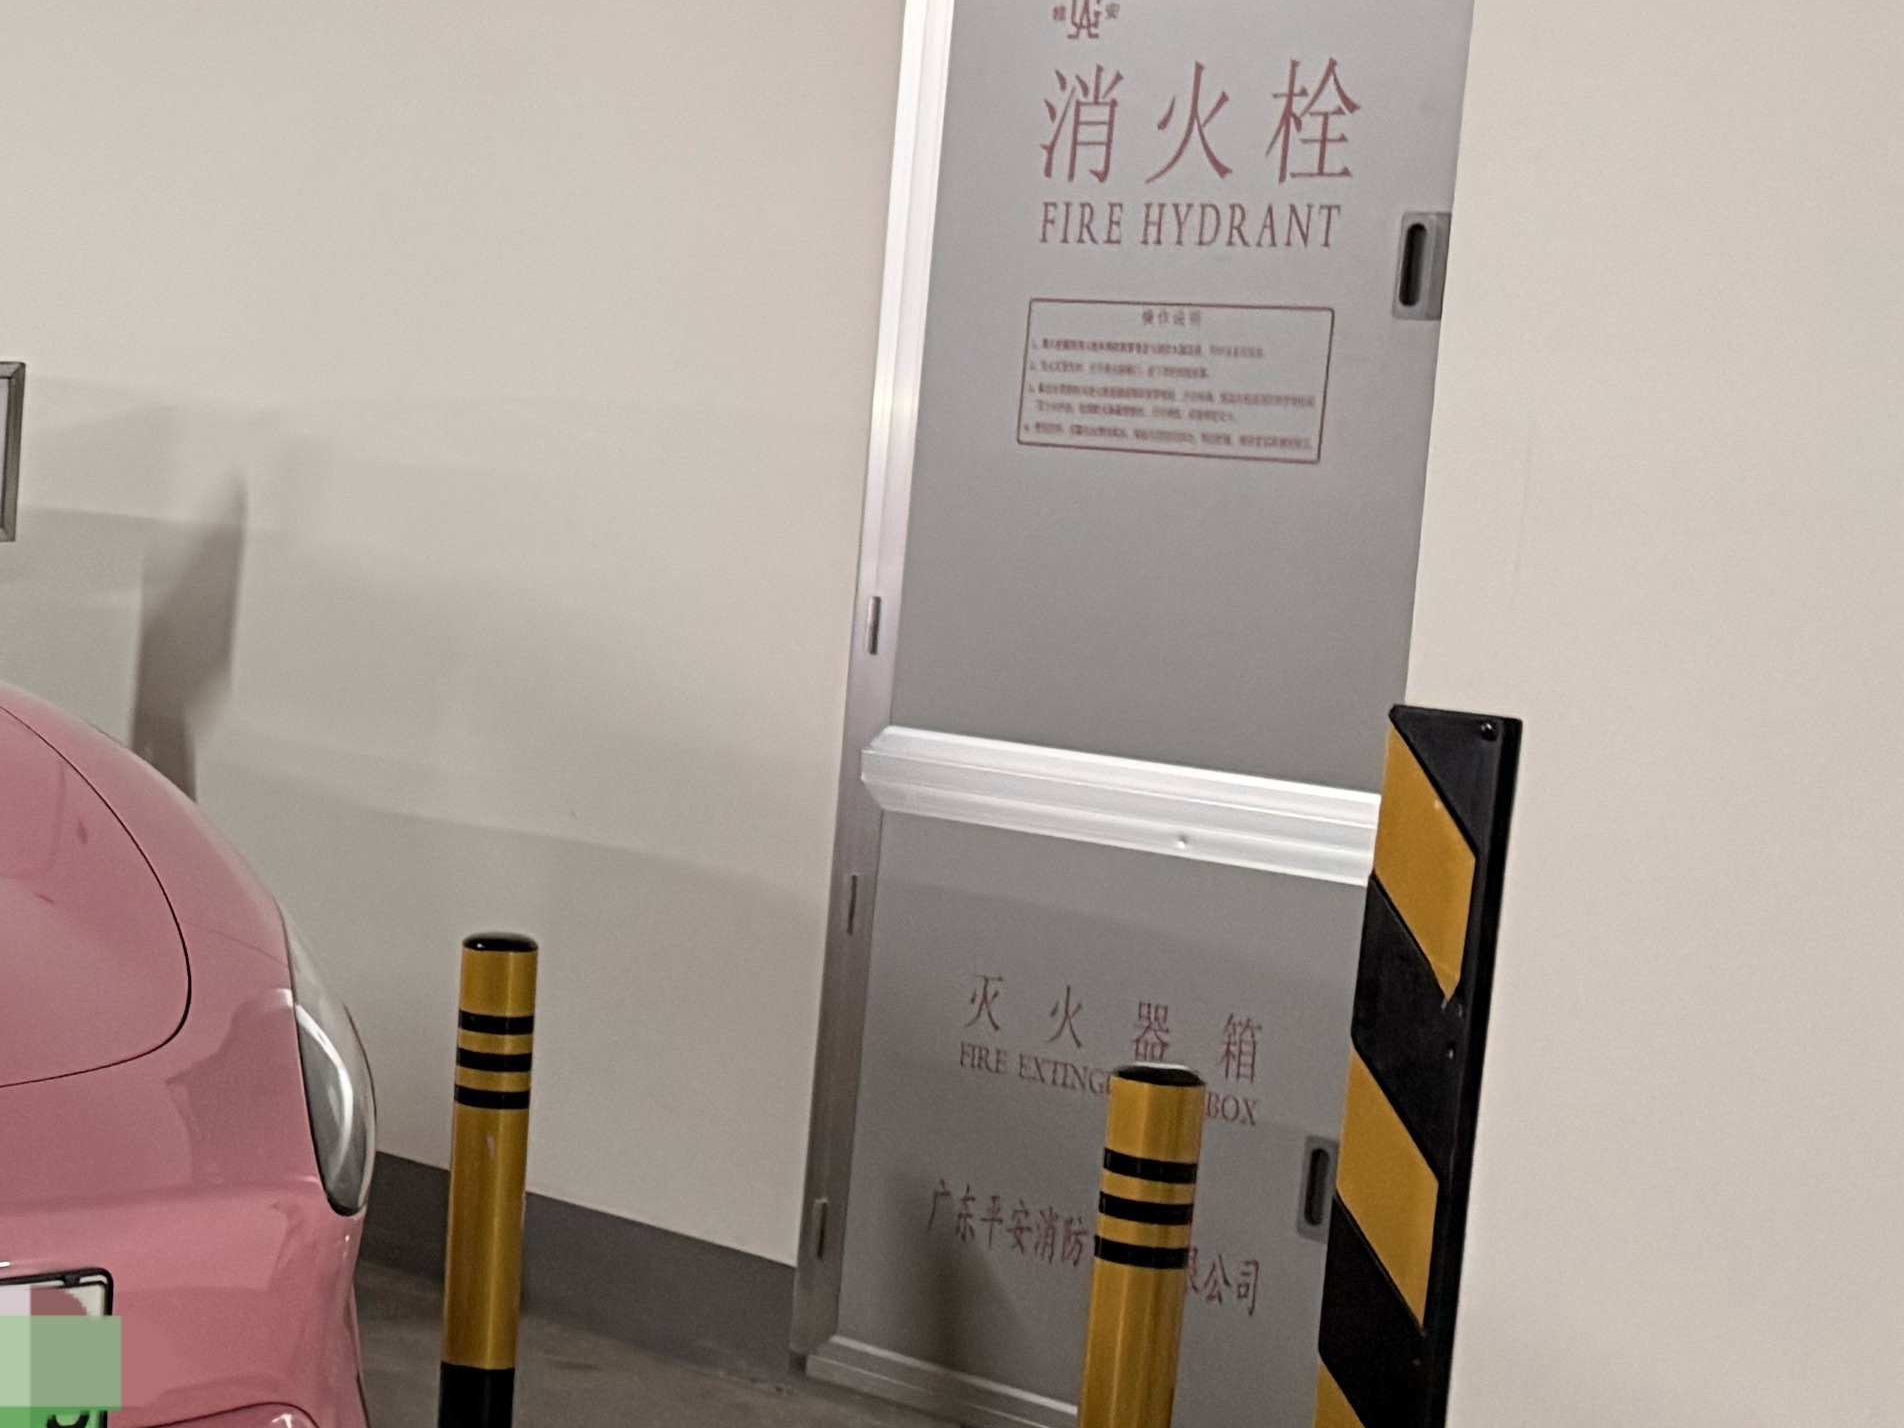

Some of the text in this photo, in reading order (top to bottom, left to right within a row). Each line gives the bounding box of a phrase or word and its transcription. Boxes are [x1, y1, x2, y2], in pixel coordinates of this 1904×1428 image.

[1040, 56, 1361, 185] 消火栓
[1039, 201, 1343, 250] FIRE HYDRANT
[959, 1040, 1008, 1074] FIRE
[1205, 1090, 1258, 1127] BOX
[964, 974, 1265, 1085] 灭火器箱
[928, 1178, 1260, 1317] 广东平安消防公司
